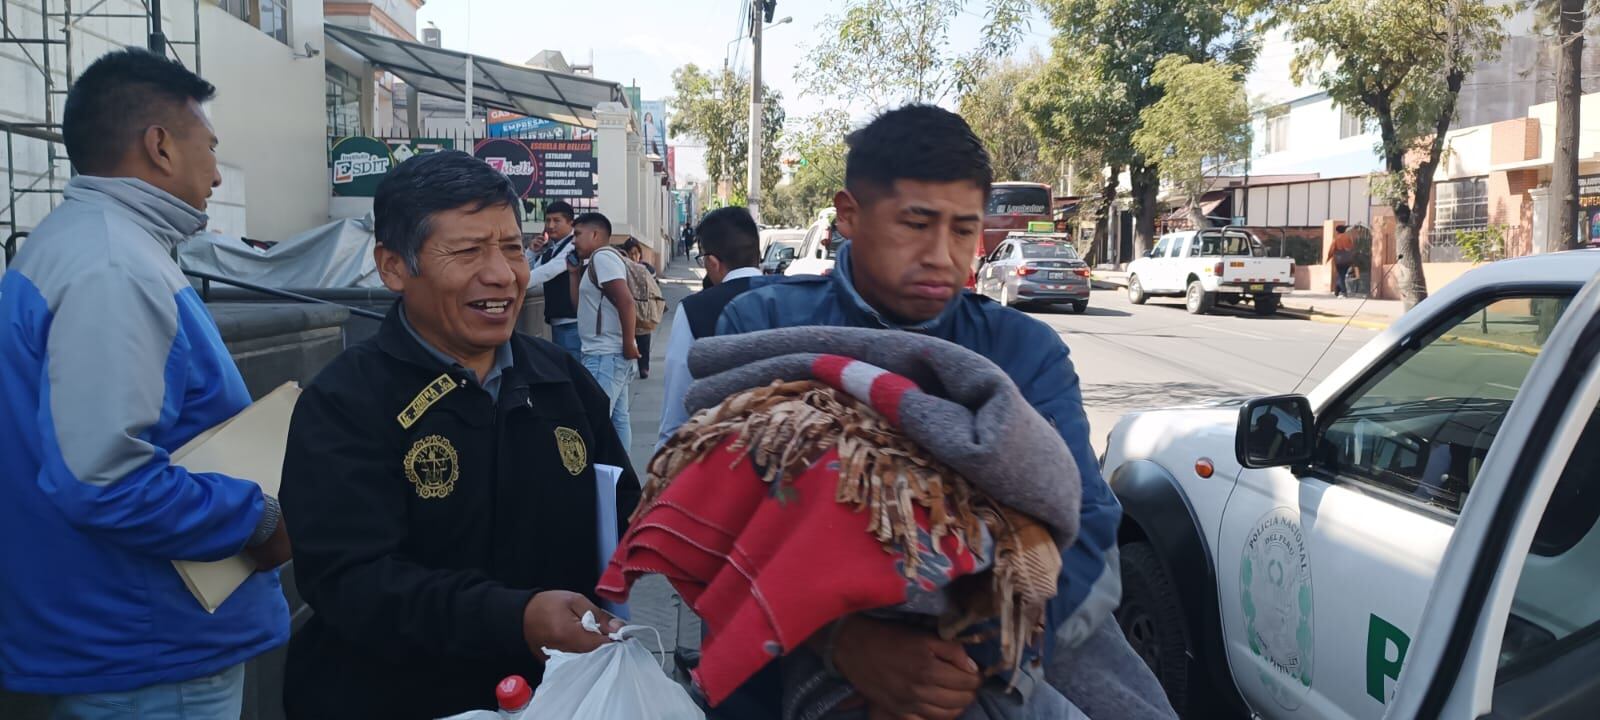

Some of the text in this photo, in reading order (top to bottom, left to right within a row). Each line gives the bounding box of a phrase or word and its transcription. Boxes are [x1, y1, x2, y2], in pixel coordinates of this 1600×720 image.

[566, 143, 592, 151] BELLEZA
[575, 170, 590, 178] UÑAS
[1265, 534, 1278, 545] DEL
[1249, 516, 1307, 573] POLICIA NACIONAL
